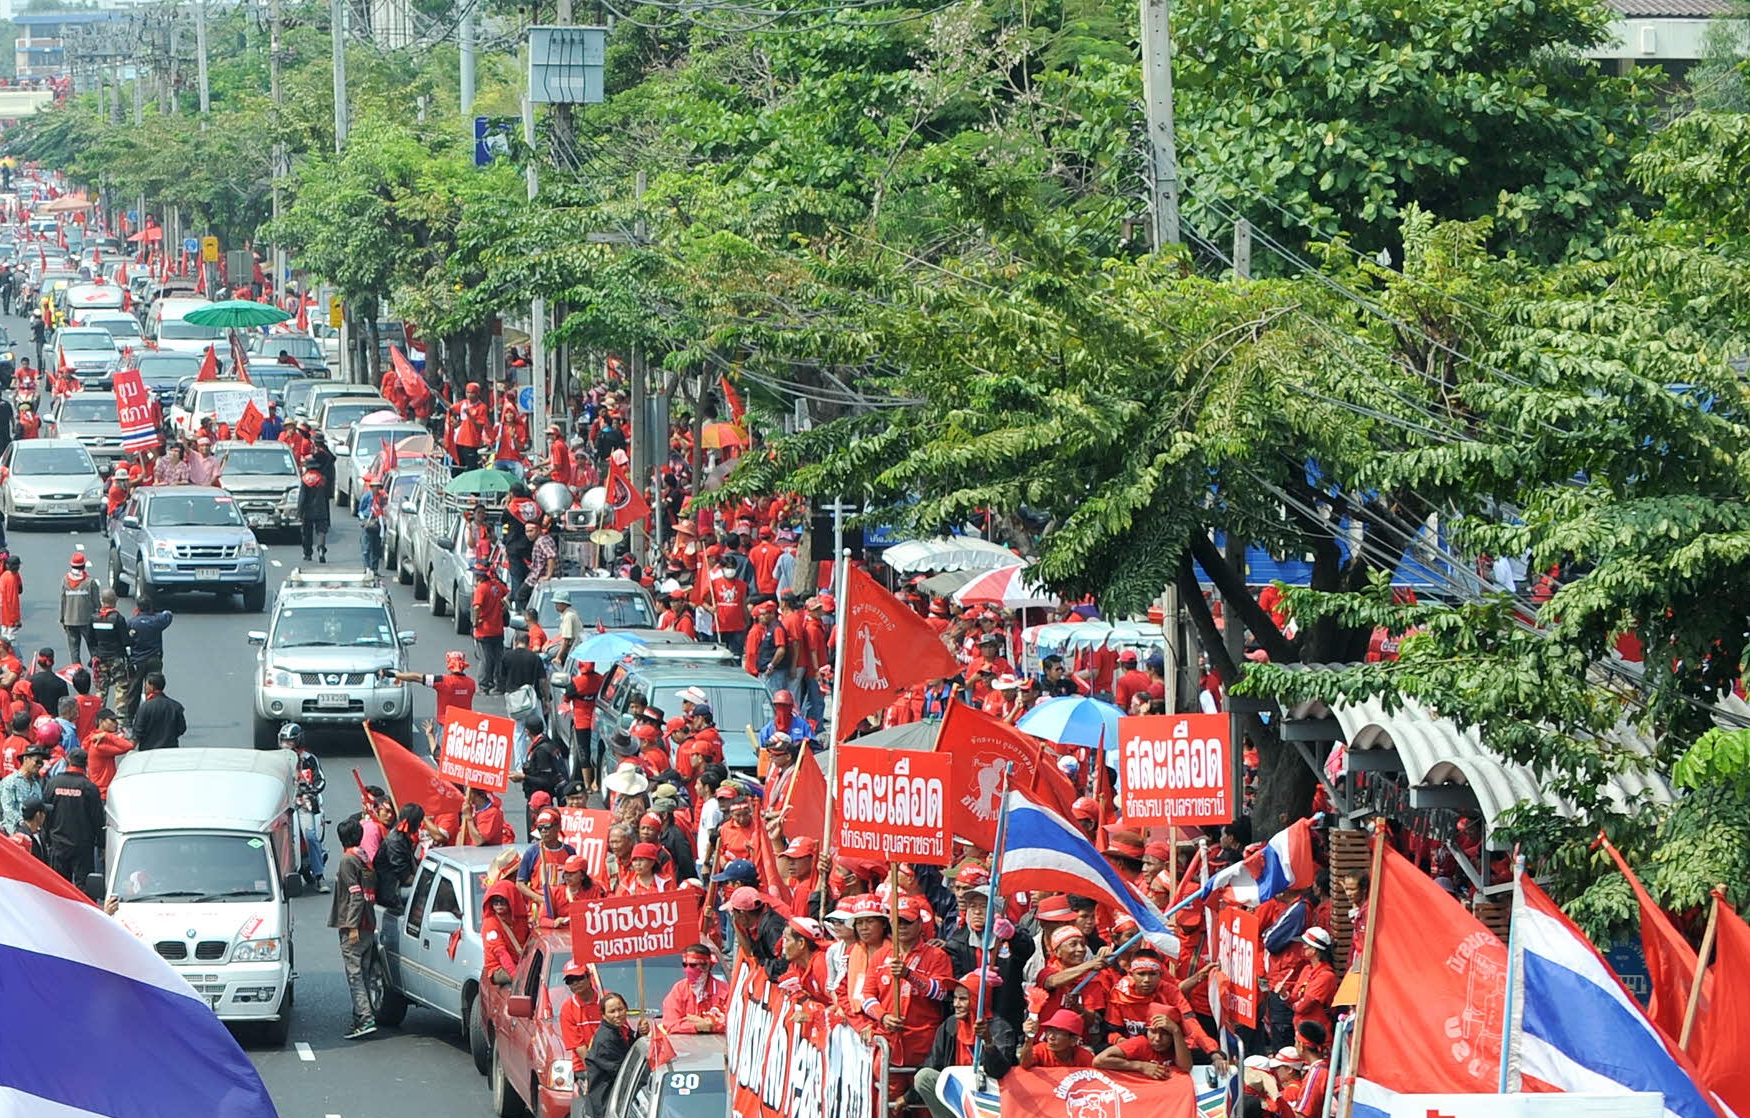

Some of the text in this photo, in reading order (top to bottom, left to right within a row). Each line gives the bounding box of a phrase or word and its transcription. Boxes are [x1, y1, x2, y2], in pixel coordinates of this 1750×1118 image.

[446, 719, 509, 770] สละเลือด
[1126, 718, 1224, 789] สละเลือด
[842, 756, 943, 829] สละเลือด
[1126, 791, 1225, 826] ชักธงรบ อุบลราชธานี
[840, 821, 944, 860] ชักธงรบ อุบลราชธานี
[585, 898, 679, 937] ชักธงรบ
[592, 925, 675, 958] อุบลราชธานี
